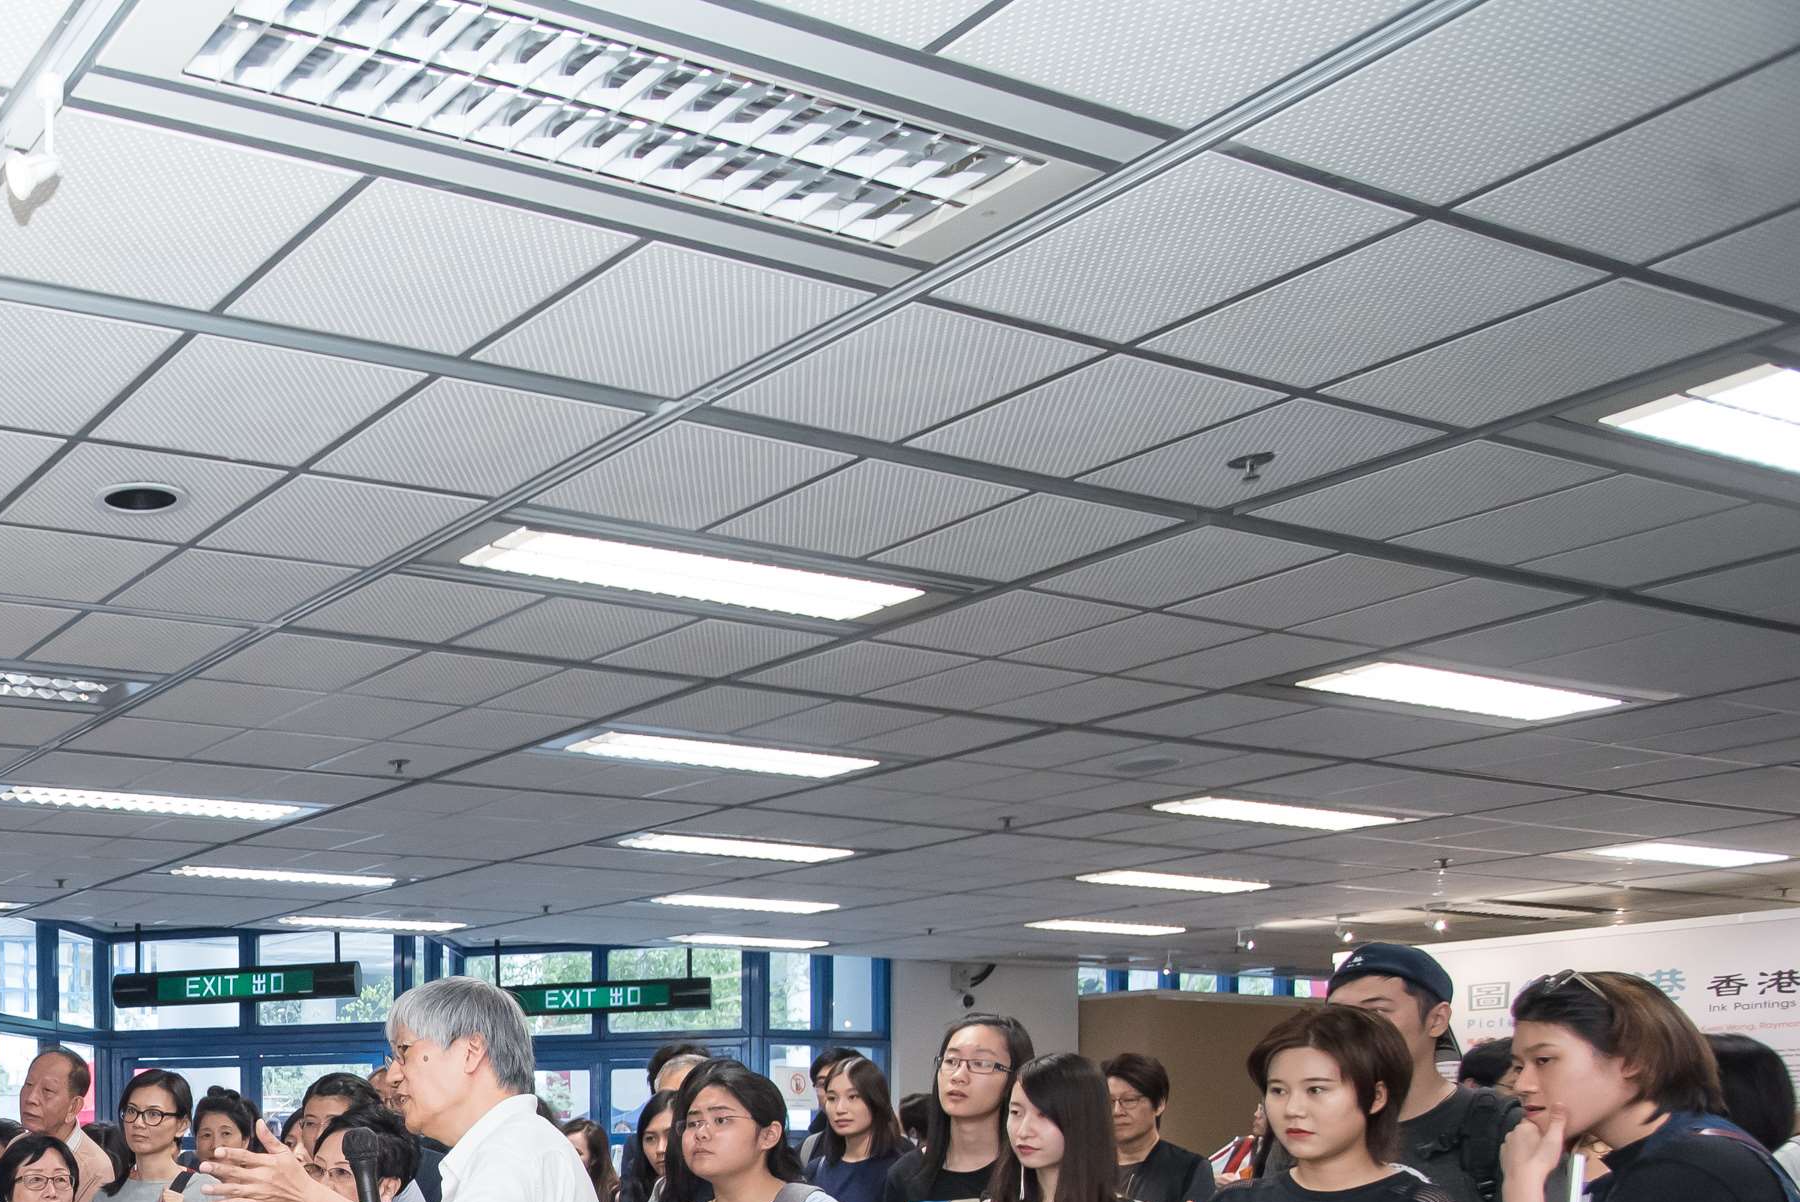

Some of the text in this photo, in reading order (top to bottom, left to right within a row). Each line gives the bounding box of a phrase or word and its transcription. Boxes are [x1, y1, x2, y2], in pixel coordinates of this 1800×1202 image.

[186, 973, 284, 997] EXIT 出口
[545, 986, 640, 1009] EXIT 出口
[1709, 1000, 1797, 1012] Ink Paintings
